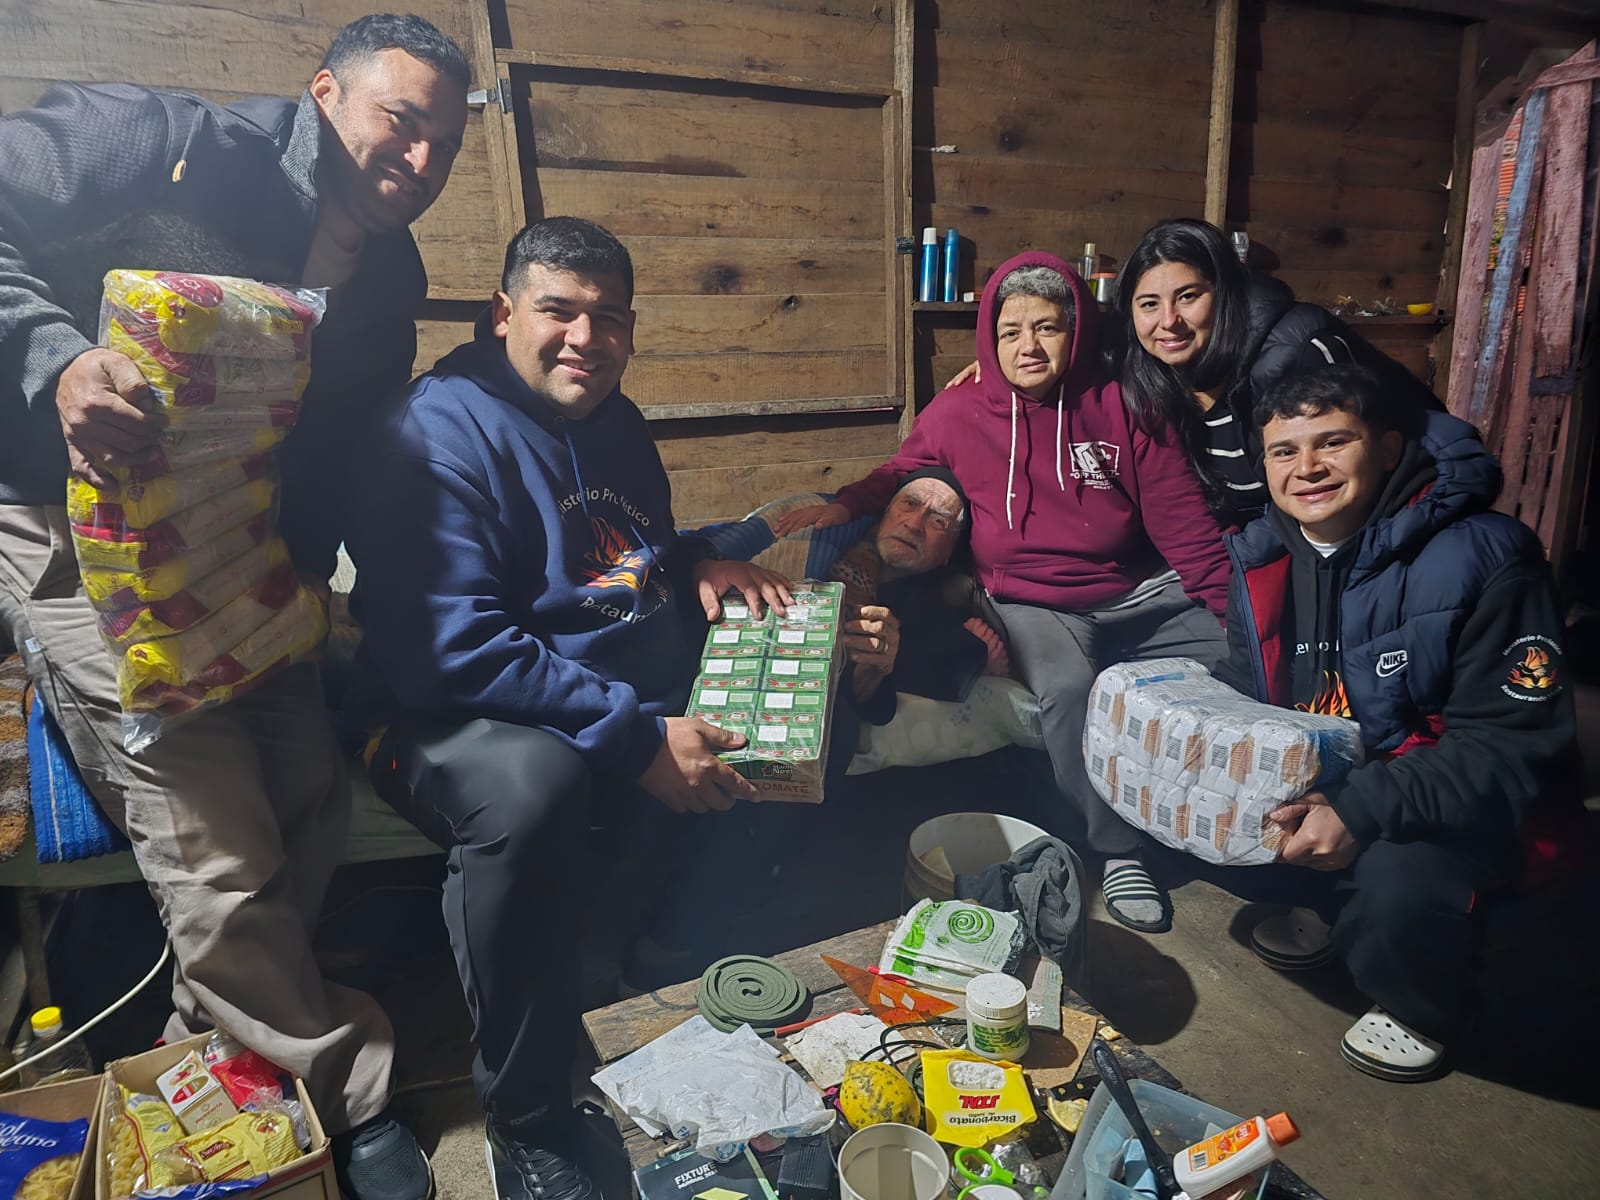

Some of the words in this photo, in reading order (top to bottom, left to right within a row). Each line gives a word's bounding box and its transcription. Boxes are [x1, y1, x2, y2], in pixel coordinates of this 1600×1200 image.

[1382, 653, 1406, 667] NIKE
[949, 1114, 1017, 1124] Bicarbonato
[674, 1160, 717, 1185] FIXTURE
